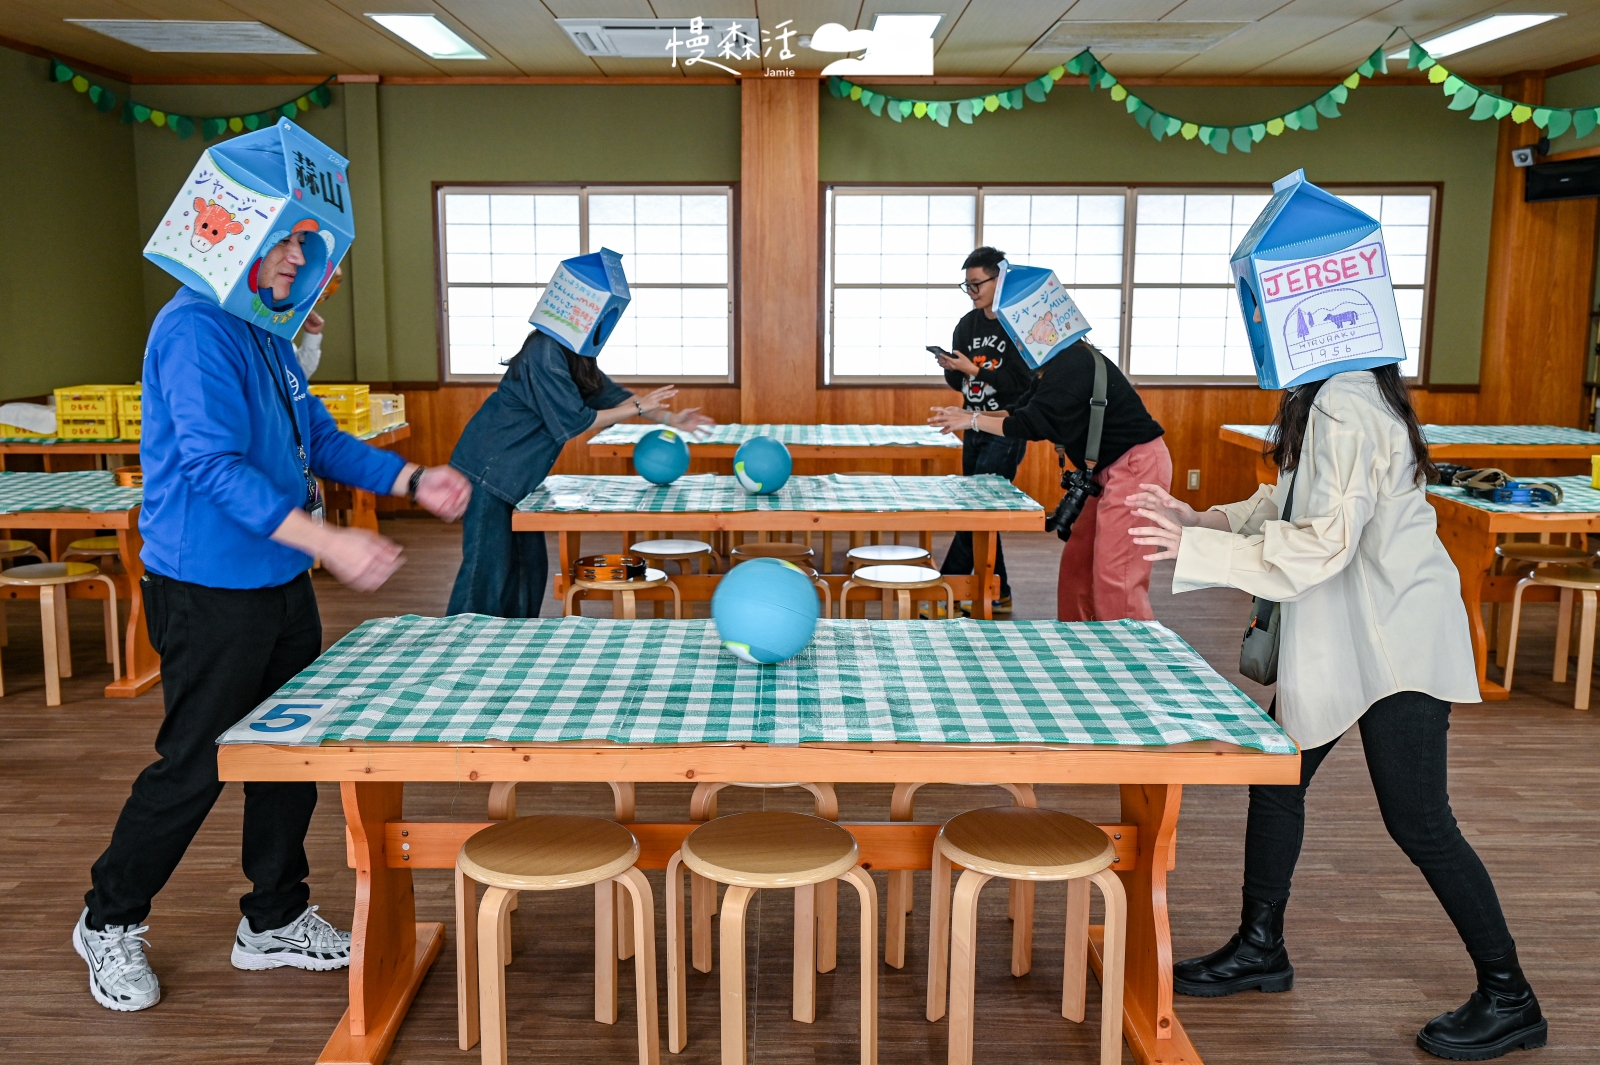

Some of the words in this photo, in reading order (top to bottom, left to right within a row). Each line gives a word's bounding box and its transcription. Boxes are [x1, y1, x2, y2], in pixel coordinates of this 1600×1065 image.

[194, 170, 269, 220] ジャージー
[1263, 248, 1378, 297] JERSEY
[1012, 286, 1059, 324] ジャージー
[1049, 294, 1070, 312] MILK
[1310, 344, 1352, 362] 1956
[249, 704, 323, 733] 5
